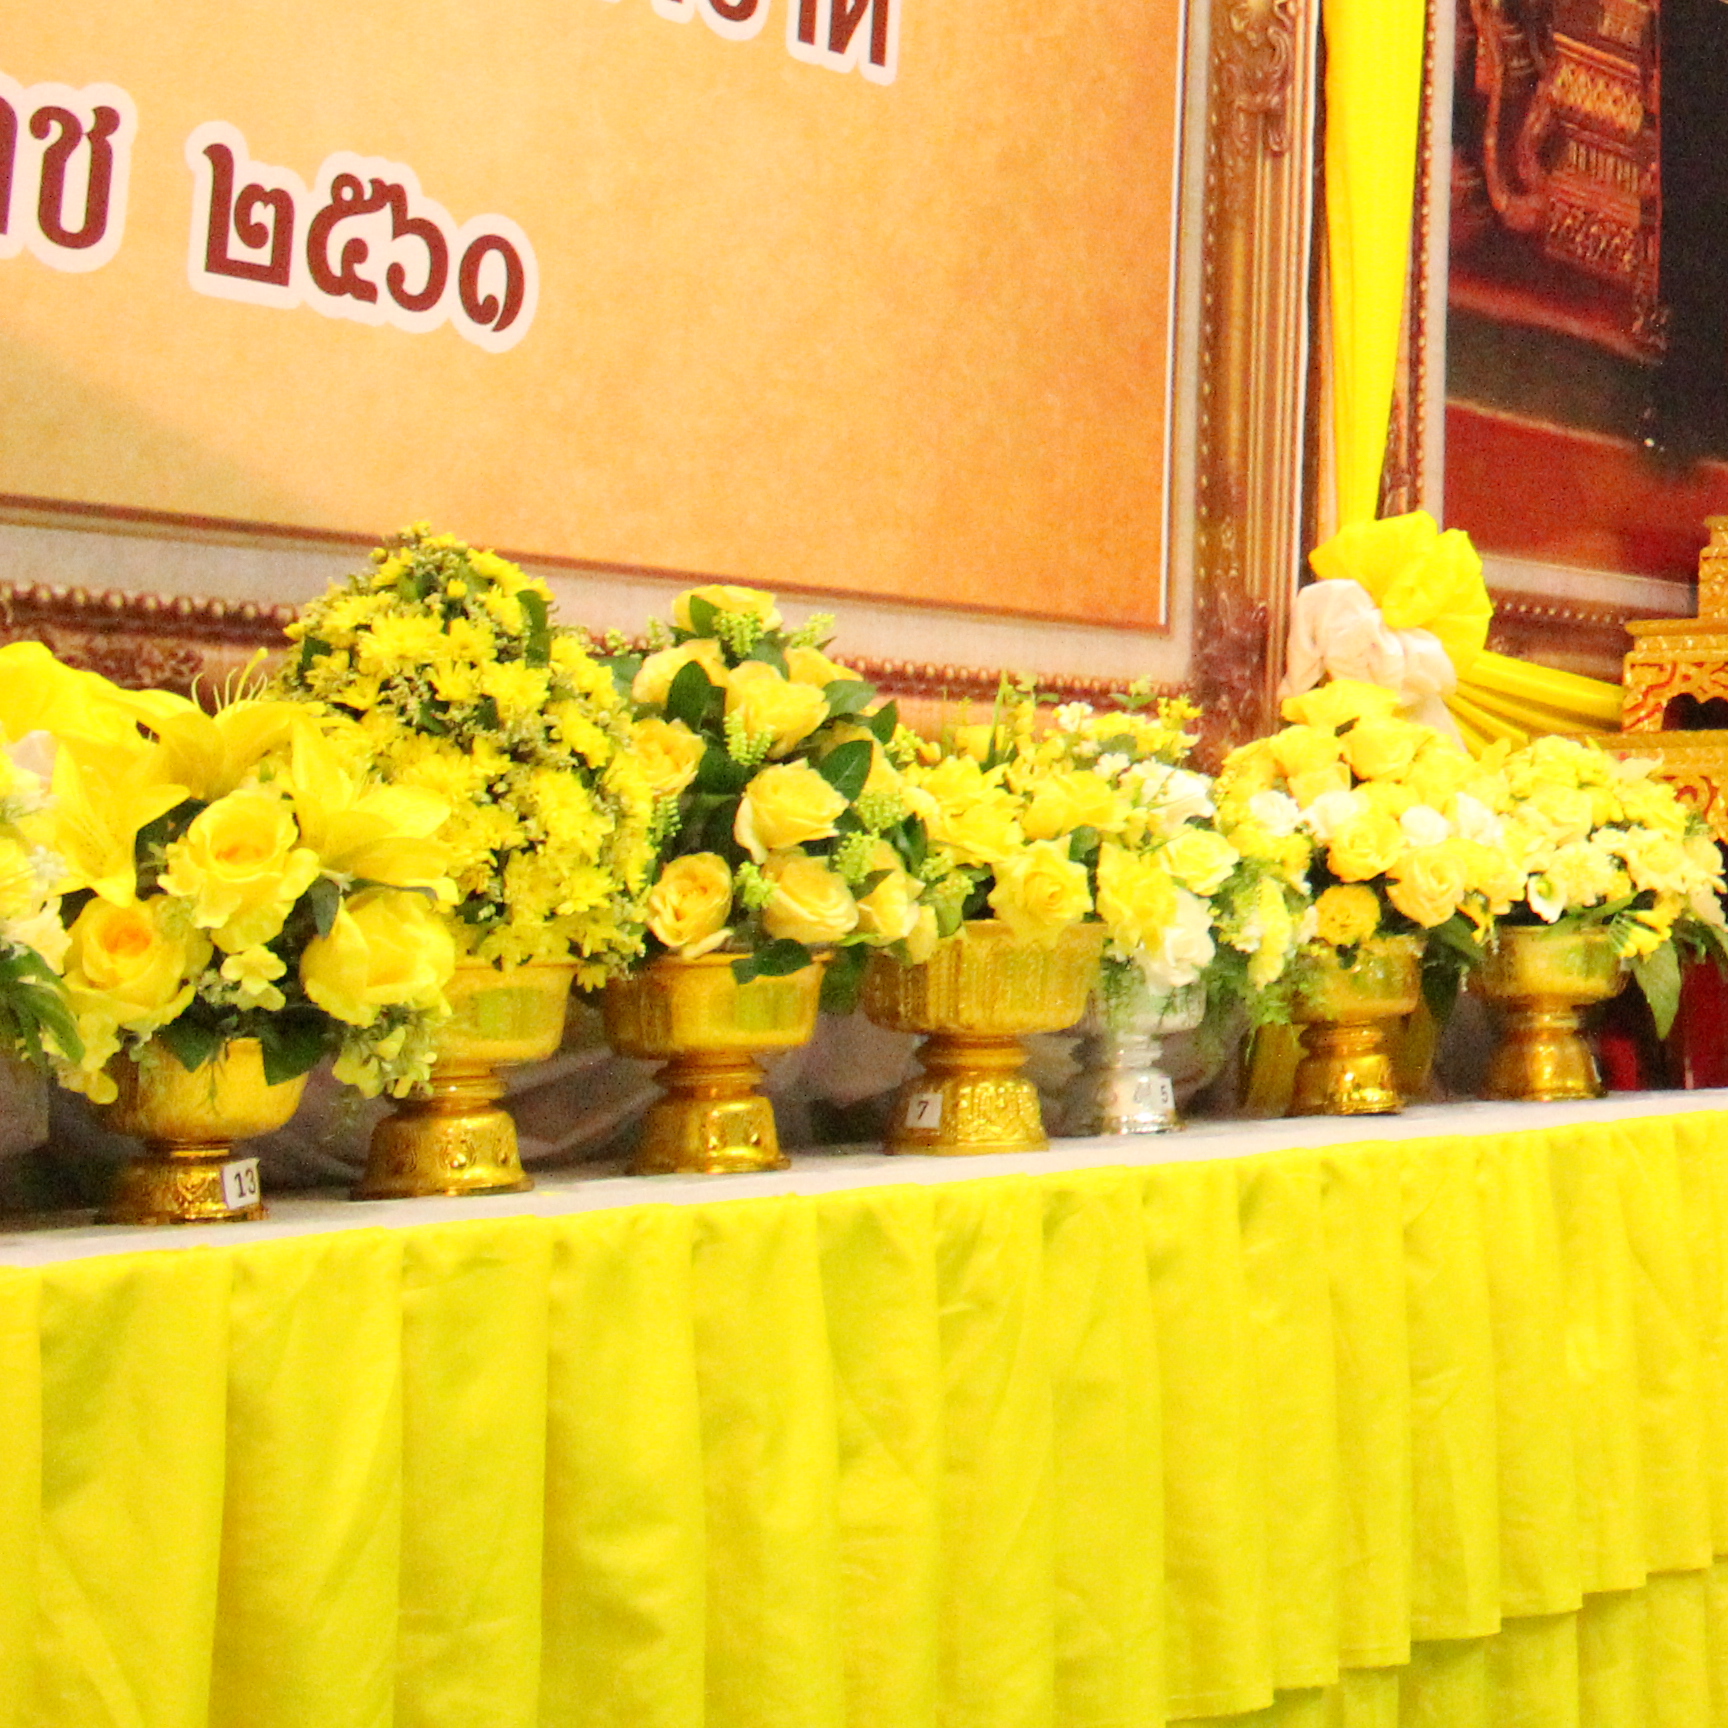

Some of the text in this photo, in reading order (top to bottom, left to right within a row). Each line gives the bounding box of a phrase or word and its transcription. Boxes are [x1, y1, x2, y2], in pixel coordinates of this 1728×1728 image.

[203, 143, 525, 332] ๒๕๖๑
[918, 1100, 930, 1120] 7
[234, 1167, 256, 1198] 13
